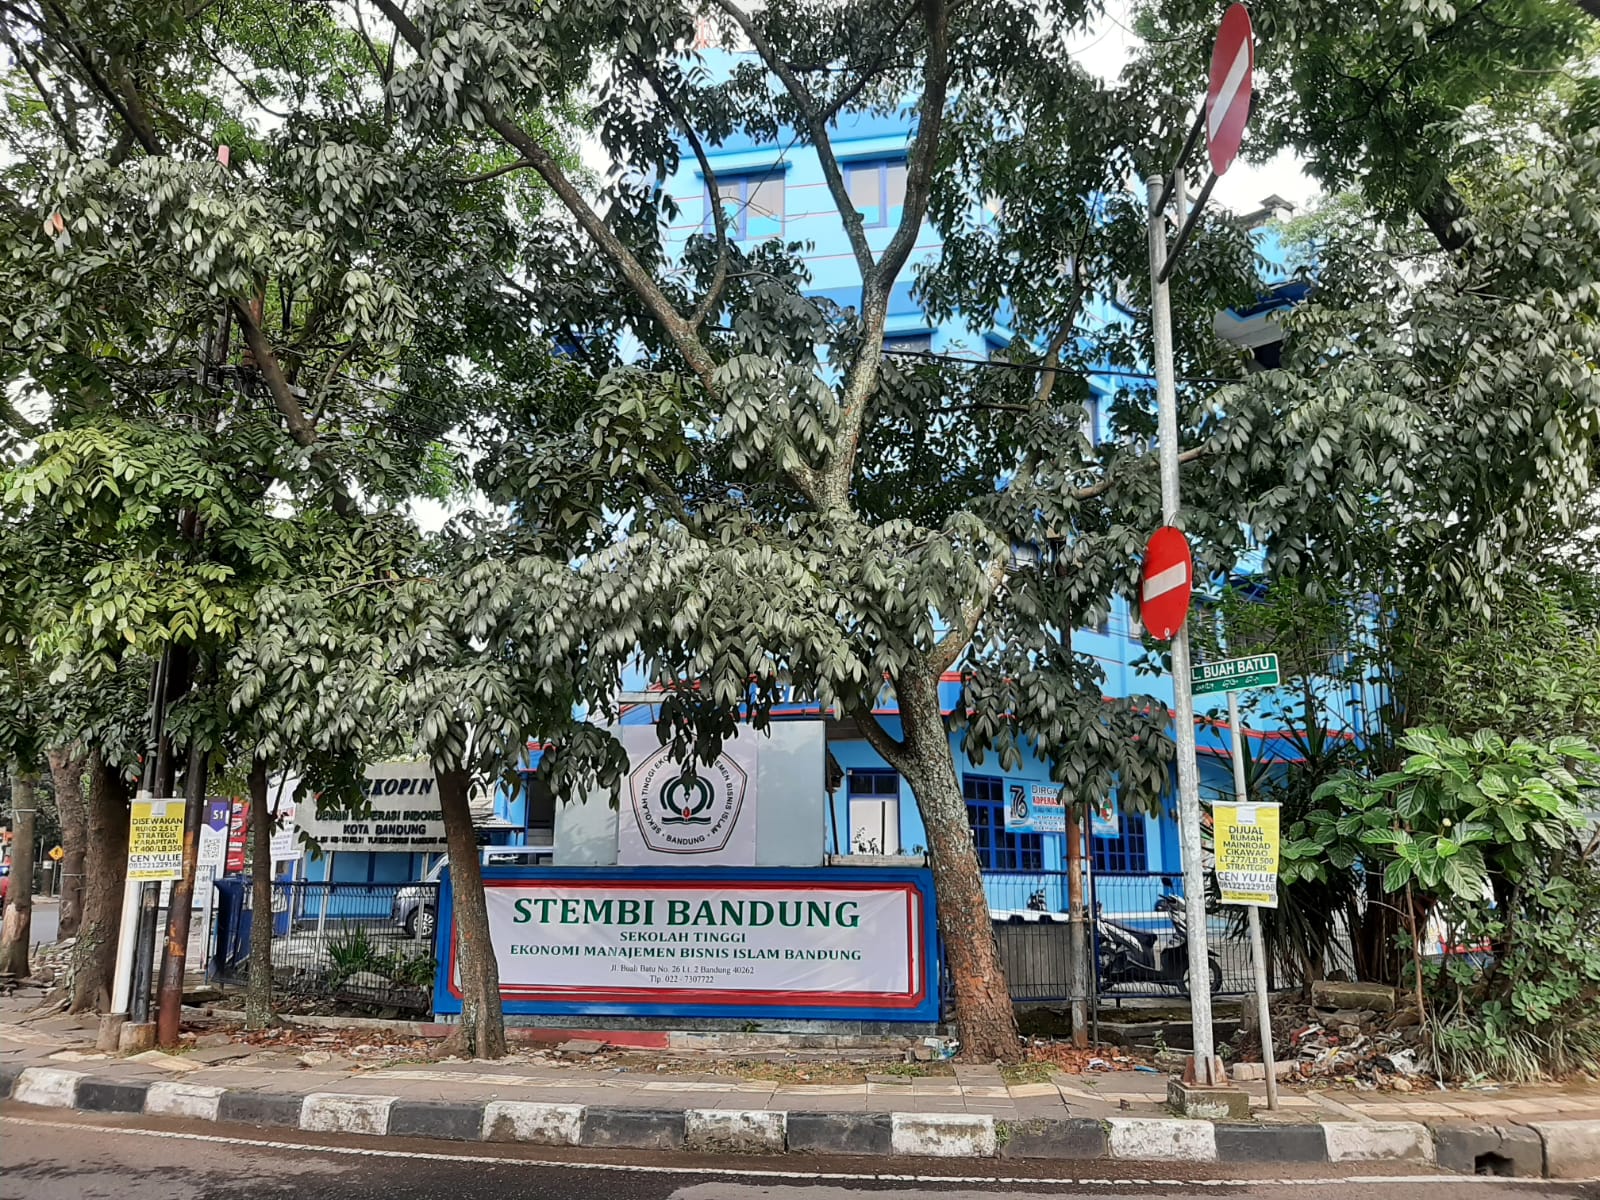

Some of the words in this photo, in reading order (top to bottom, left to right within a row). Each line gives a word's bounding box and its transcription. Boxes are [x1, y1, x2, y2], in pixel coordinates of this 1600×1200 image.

[1191, 668, 1201, 680] L.
[1203, 662, 1235, 678] BUAH
[1237, 657, 1270, 673] BATU
[641, 768, 657, 797] TINGGI
[1031, 784, 1058, 795] DIRGA
[725, 782, 734, 811] BISNIS
[132, 817, 183, 825] DISEWAKAN
[403, 810, 444, 821] INDONE
[641, 797, 662, 835] SEKOLAH
[711, 811, 733, 836] ISLAM
[343, 824, 369, 835] KOTA
[375, 825, 427, 836] BANDUNG
[1228, 825, 1264, 835] DIJUAL
[134, 838, 178, 846] KARAPITAN
[666, 834, 706, 846] BANDUNG
[1230, 834, 1263, 842] RUMAH
[1223, 841, 1271, 850] MAINROAD
[130, 855, 150, 863] CEN
[152, 854, 166, 862] YU
[167, 853, 182, 862] LIE
[1225, 848, 1269, 857] CIKAWAO
[1225, 863, 1267, 872] STRATEGIS
[1217, 872, 1239, 881] CEN
[1241, 872, 1257, 882] YU
[1259, 873, 1276, 883] LIE
[512, 897, 656, 926] STEMBI
[666, 899, 860, 928] BANDUNG
[619, 931, 689, 943] SEKOLAH
[693, 932, 746, 943] TINGGI
[510, 944, 580, 956] EKONOMI
[584, 945, 675, 959] MANAJEMEN
[680, 947, 729, 959] BISNIS
[733, 948, 780, 960] ISLAM
[784, 949, 862, 961] BANDUNG
[620, 964, 638, 973] Buah
[640, 964, 656, 973] Batu
[672, 965, 681, 973] 26
[700, 965, 731, 976] Bandung
[732, 966, 755, 975] 40262
[664, 975, 678, 983] 022
[685, 975, 714, 984] 7307722
